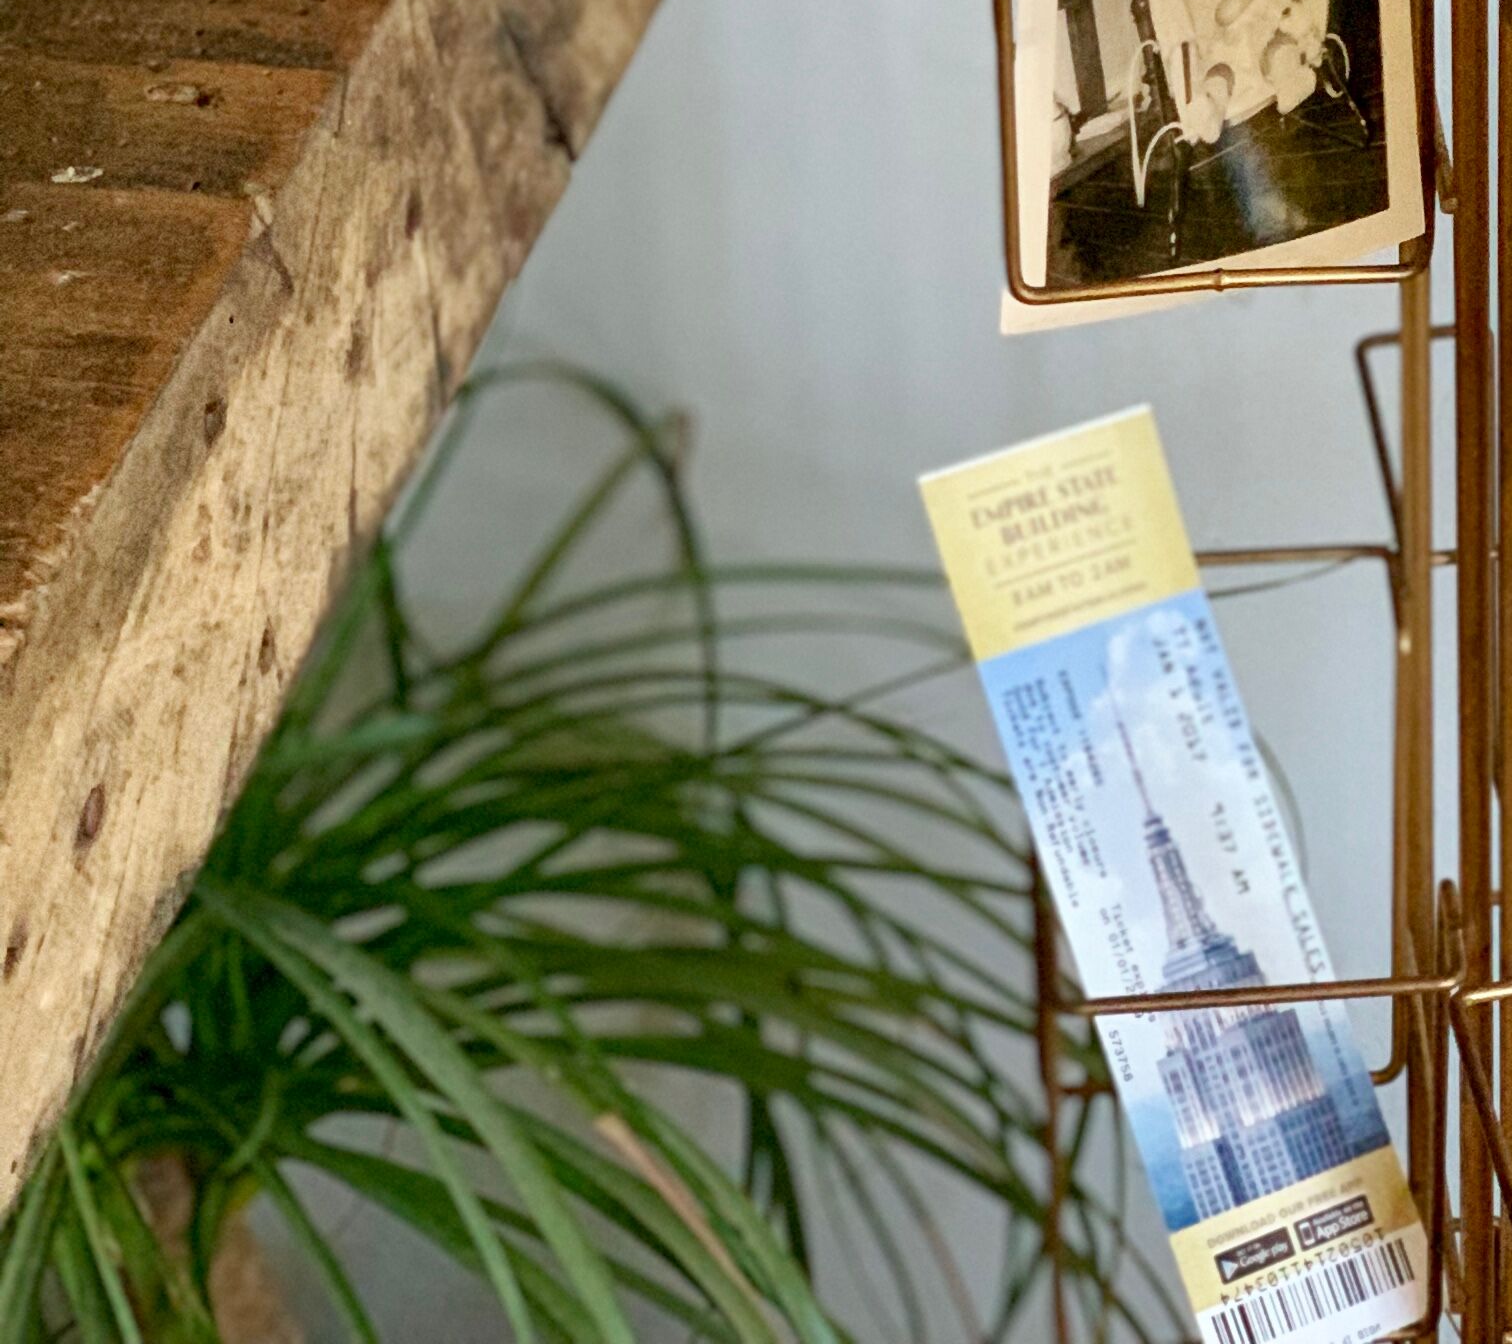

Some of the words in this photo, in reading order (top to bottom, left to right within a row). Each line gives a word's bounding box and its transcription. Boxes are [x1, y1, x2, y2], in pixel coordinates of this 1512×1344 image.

[968, 485, 1051, 529] EMPIRE
[1055, 464, 1119, 501] STATE
[998, 495, 1109, 546] BUILDING
[983, 511, 1134, 576] EXPERIENCE
[1099, 907, 1111, 925] on
[1110, 903, 1135, 953] Ticket
[1206, 1214, 1277, 1248] DOWNLOAD
[1277, 1201, 1305, 1218] OUR
[1315, 1220, 1341, 1240] App
[1338, 1208, 1369, 1229] Store
[1238, 1248, 1270, 1269] Google
[1269, 1240, 1289, 1256] play
